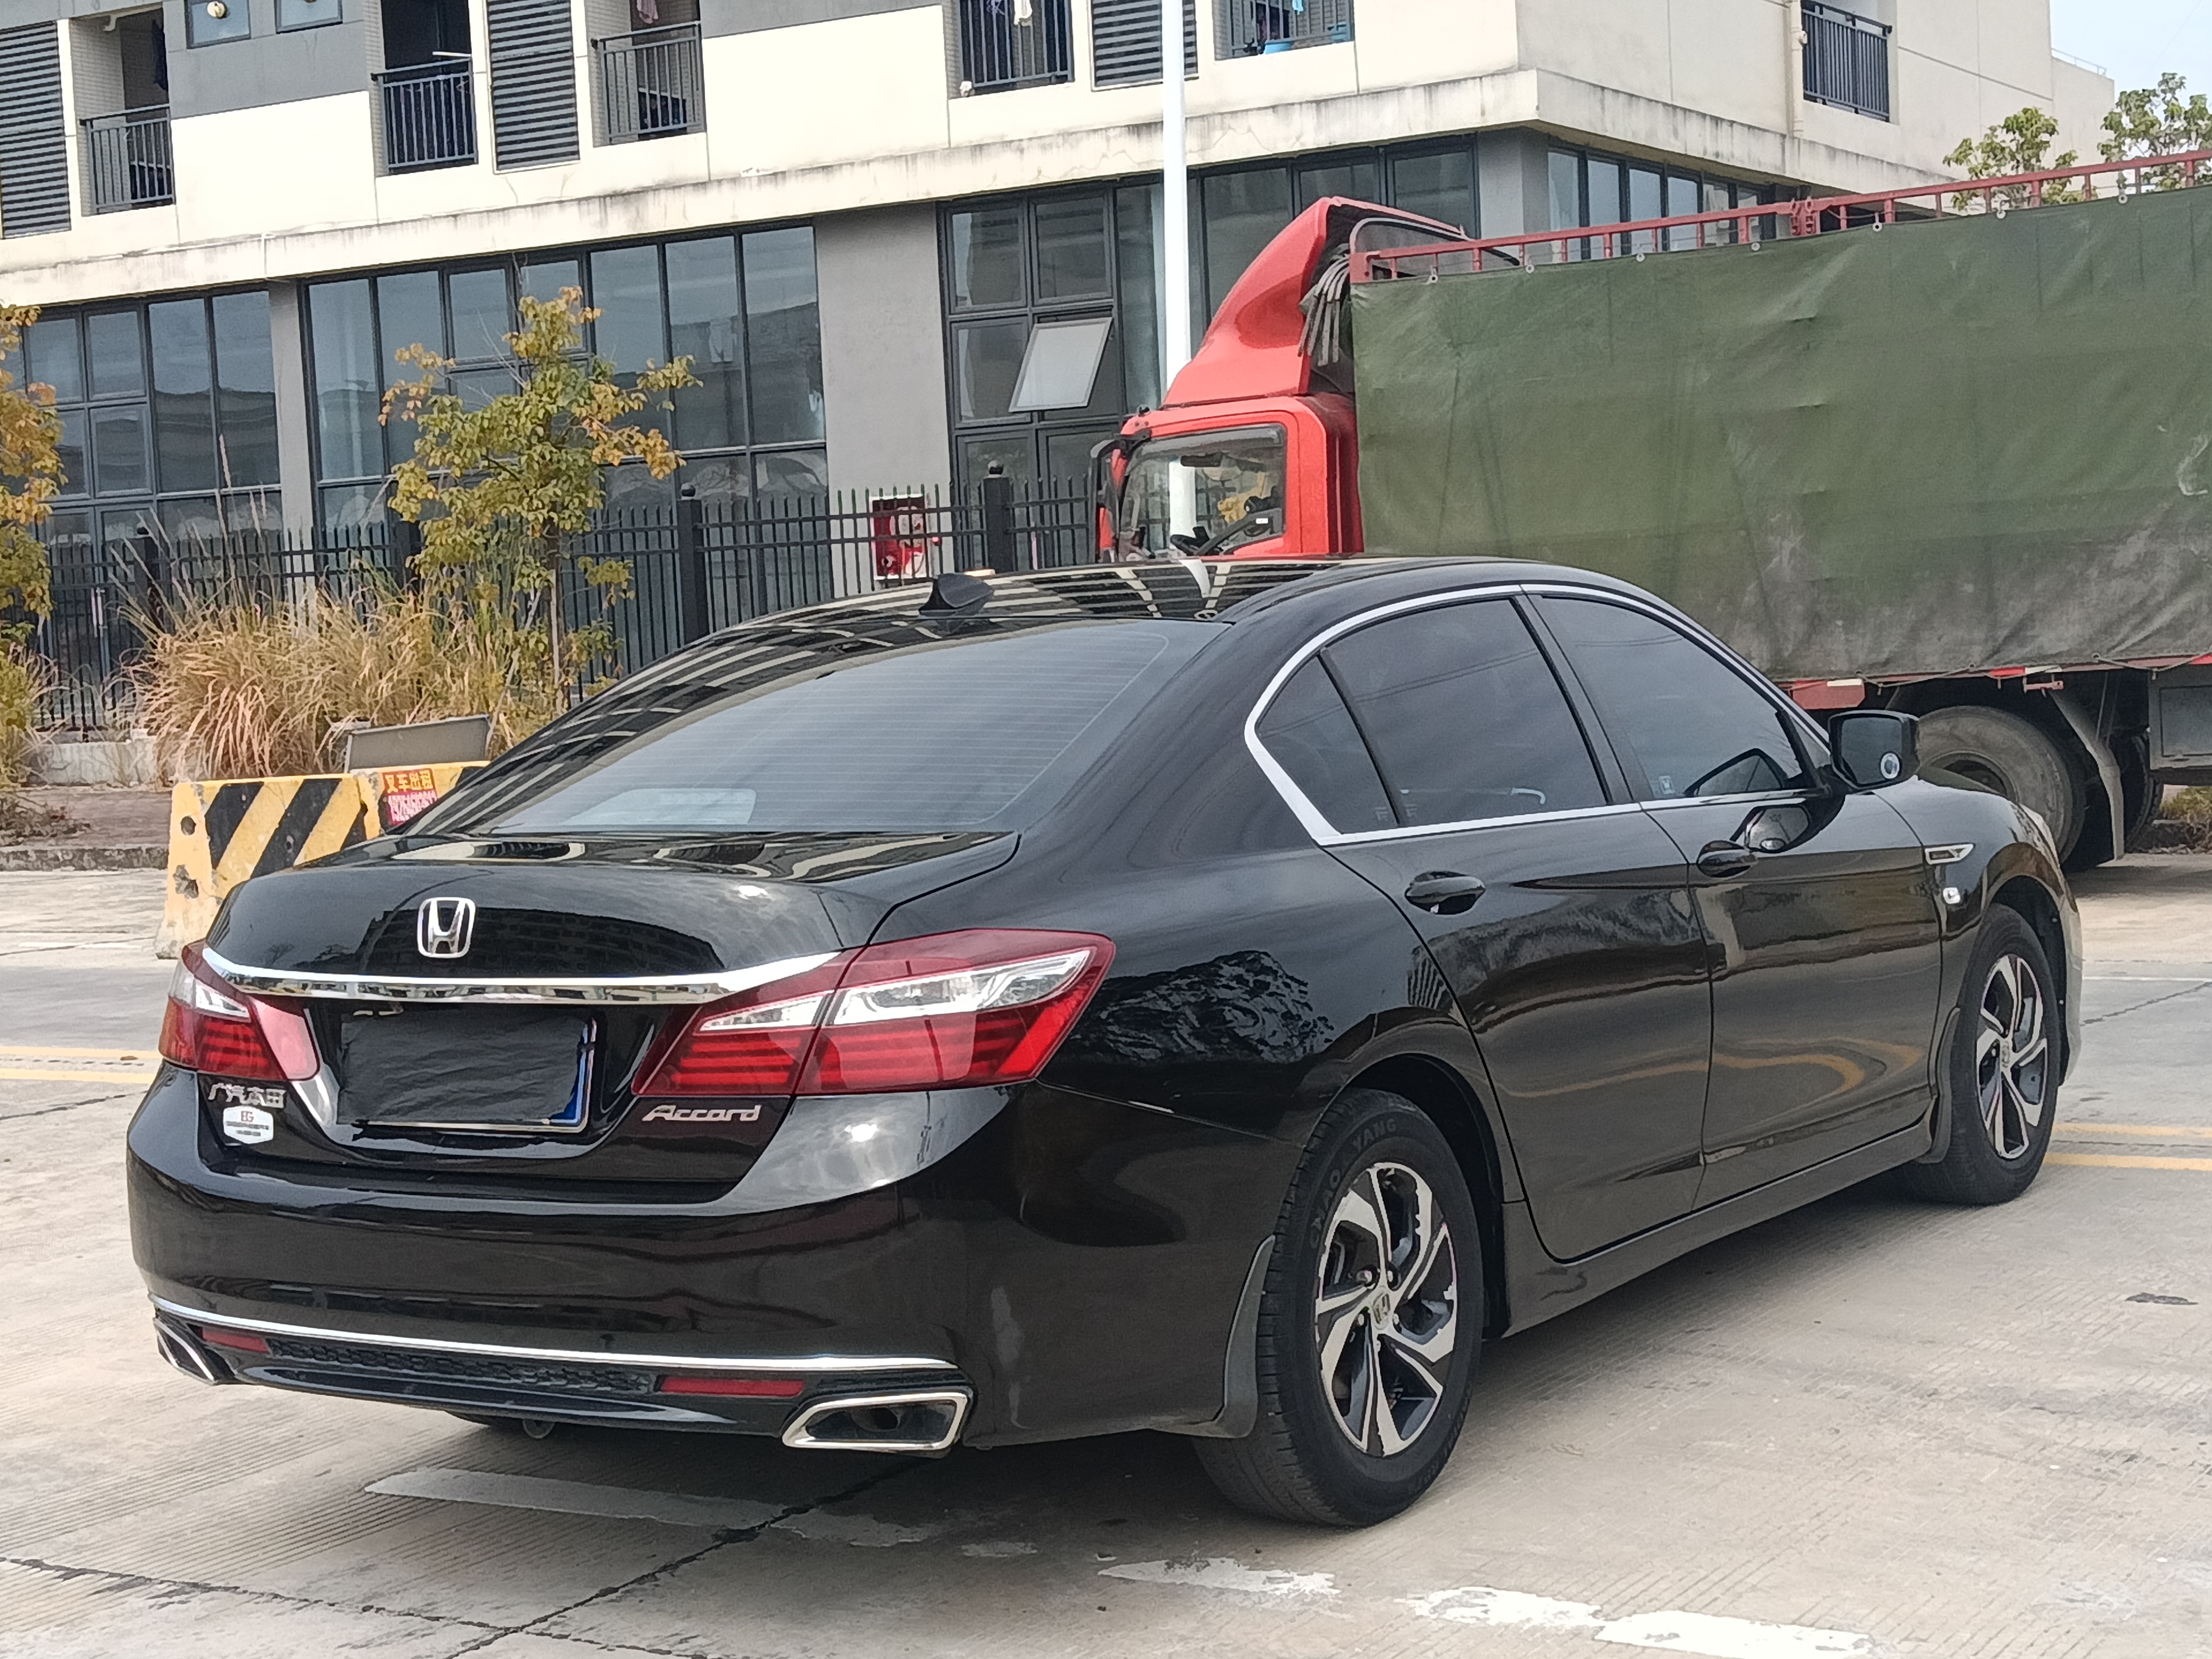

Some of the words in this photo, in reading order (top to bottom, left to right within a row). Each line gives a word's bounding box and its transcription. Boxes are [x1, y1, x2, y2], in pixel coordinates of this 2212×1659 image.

[207, 1083, 287, 1108] 广汽本田
[642, 1104, 762, 1122] Accord
[1353, 1118, 1397, 1153] YANG
